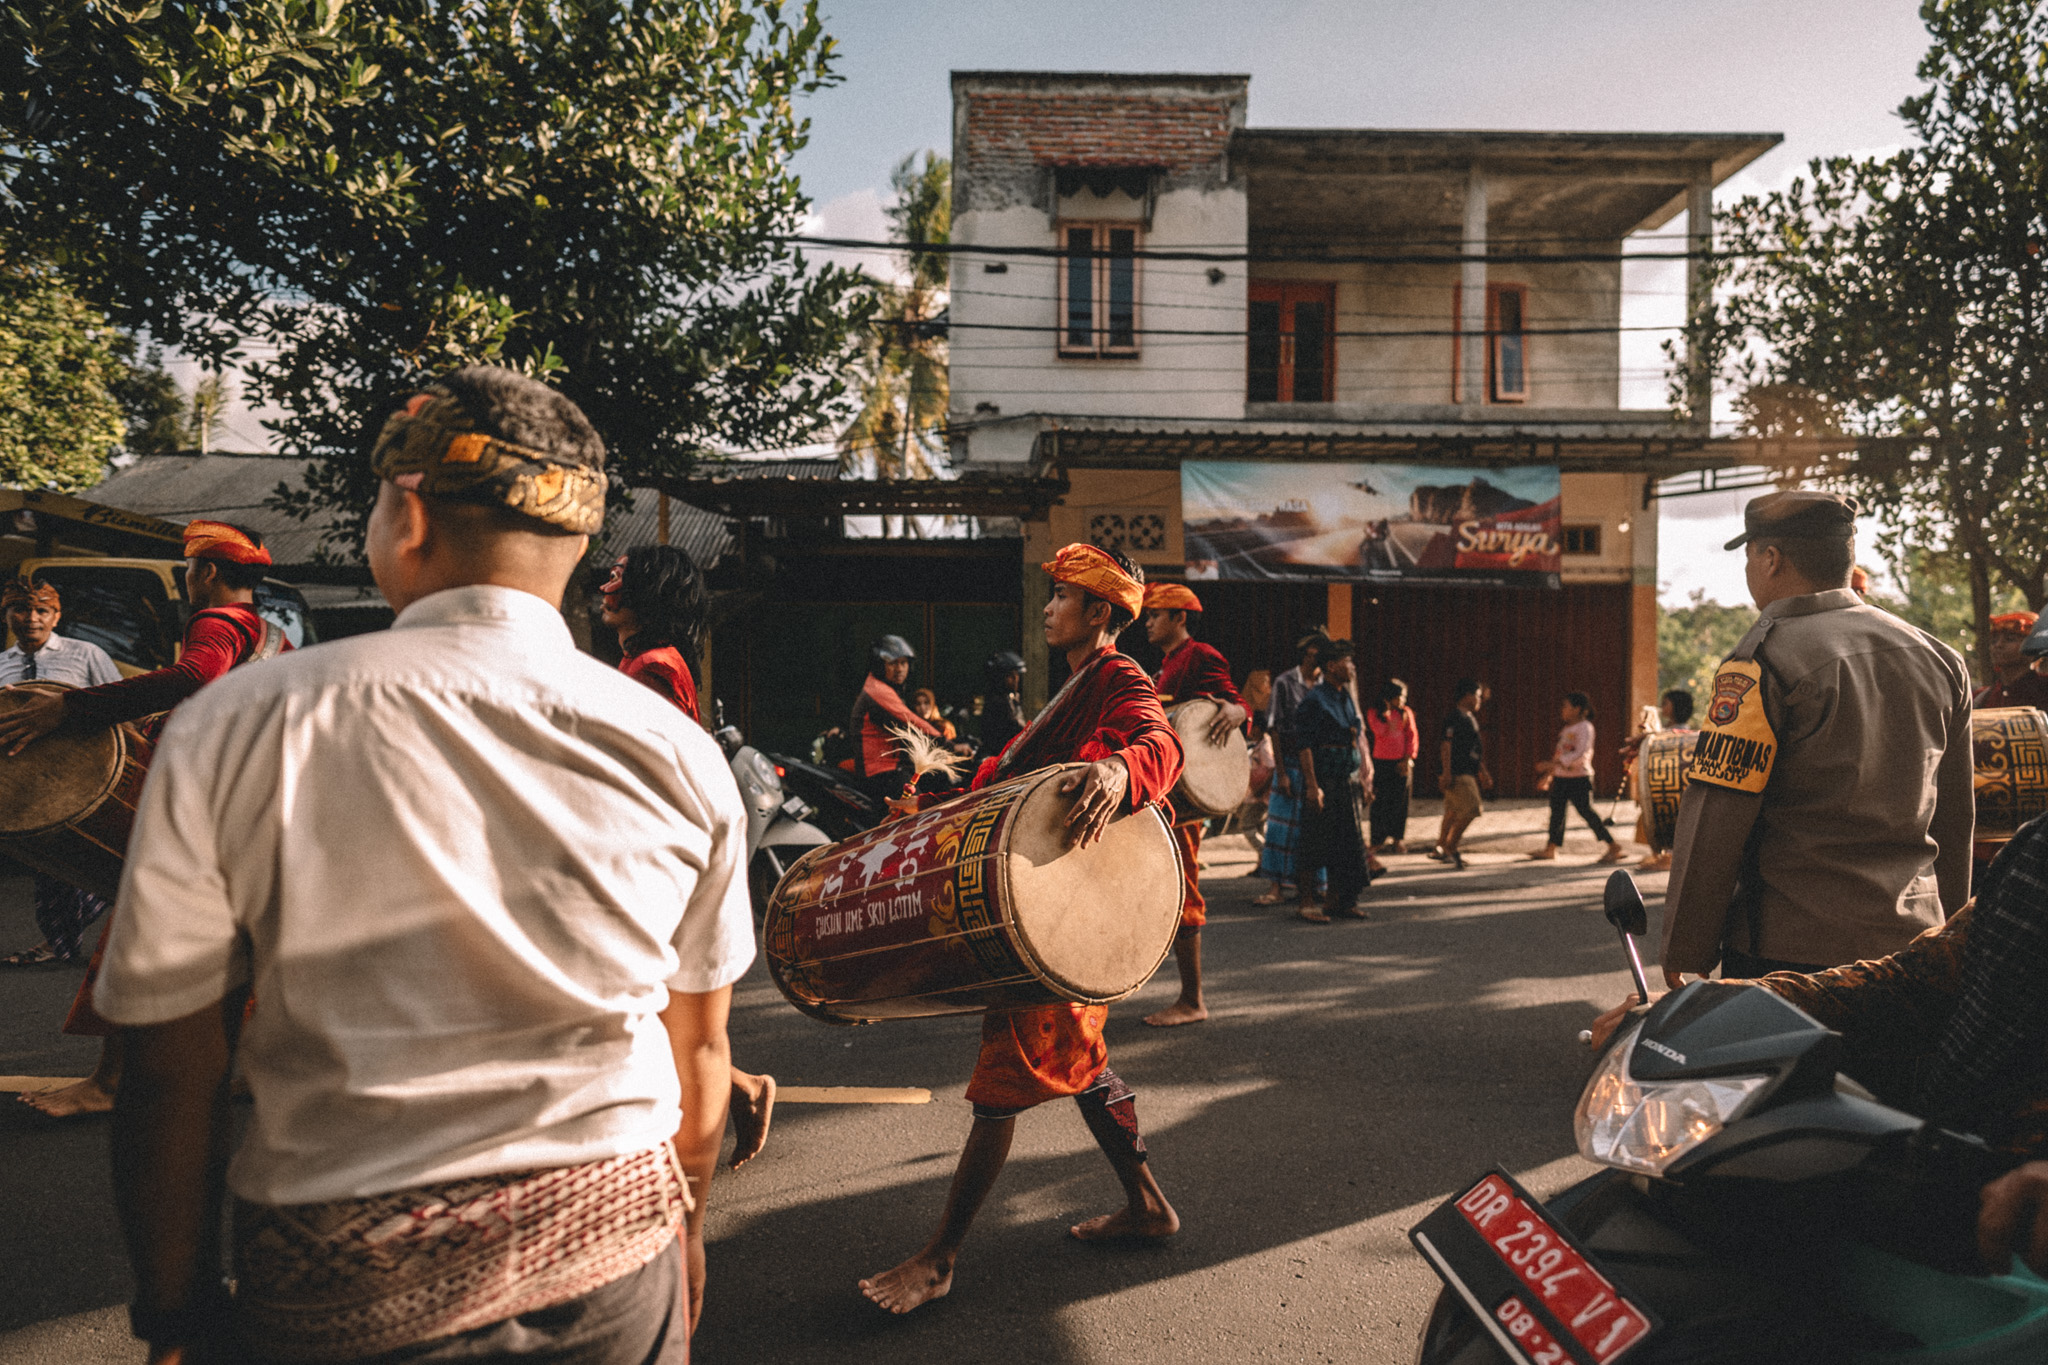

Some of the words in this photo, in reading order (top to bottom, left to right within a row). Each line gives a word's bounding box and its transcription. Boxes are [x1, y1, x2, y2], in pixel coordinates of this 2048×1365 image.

[1456, 521, 1560, 568] Surya
[1699, 766, 1743, 784] PUJUT
[888, 889, 923, 924] LOTIM
[1641, 1038, 1687, 1066] HONDA
[1460, 1181, 1509, 1228] DR
[1495, 1220, 1580, 1297] 2394
